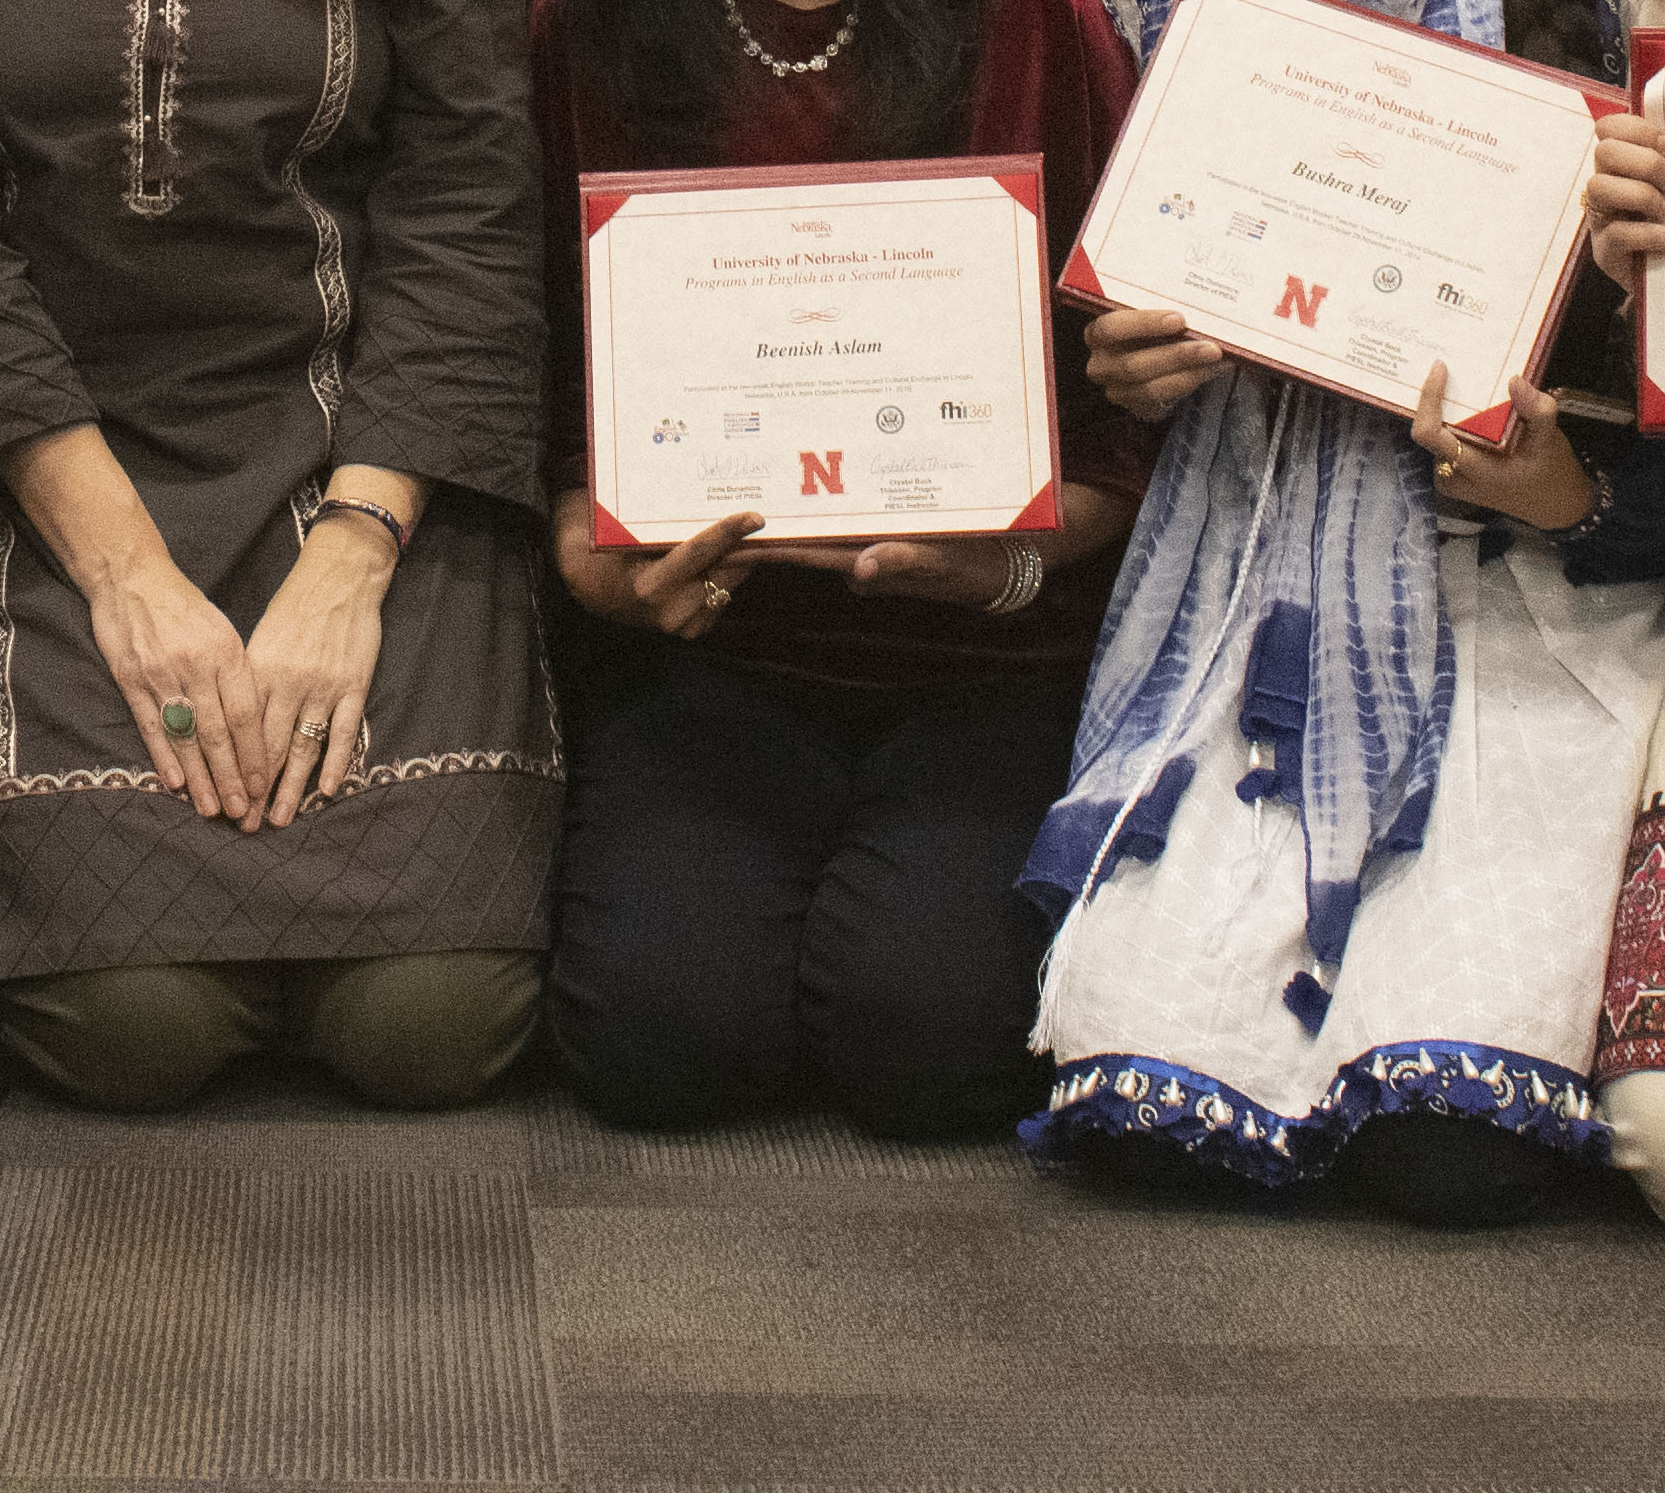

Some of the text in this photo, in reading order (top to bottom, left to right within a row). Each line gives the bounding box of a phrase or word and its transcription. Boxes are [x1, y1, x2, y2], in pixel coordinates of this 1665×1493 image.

[1283, 63, 1498, 147] University of Nebraska Lincoln
[1291, 160, 1411, 215] Bushra Meraj
[713, 248, 934, 270] University of Nebraska Lincoln
[1274, 271, 1330, 331] N
[755, 338, 882, 359] Beenish Aslam
[799, 450, 845, 497] N
